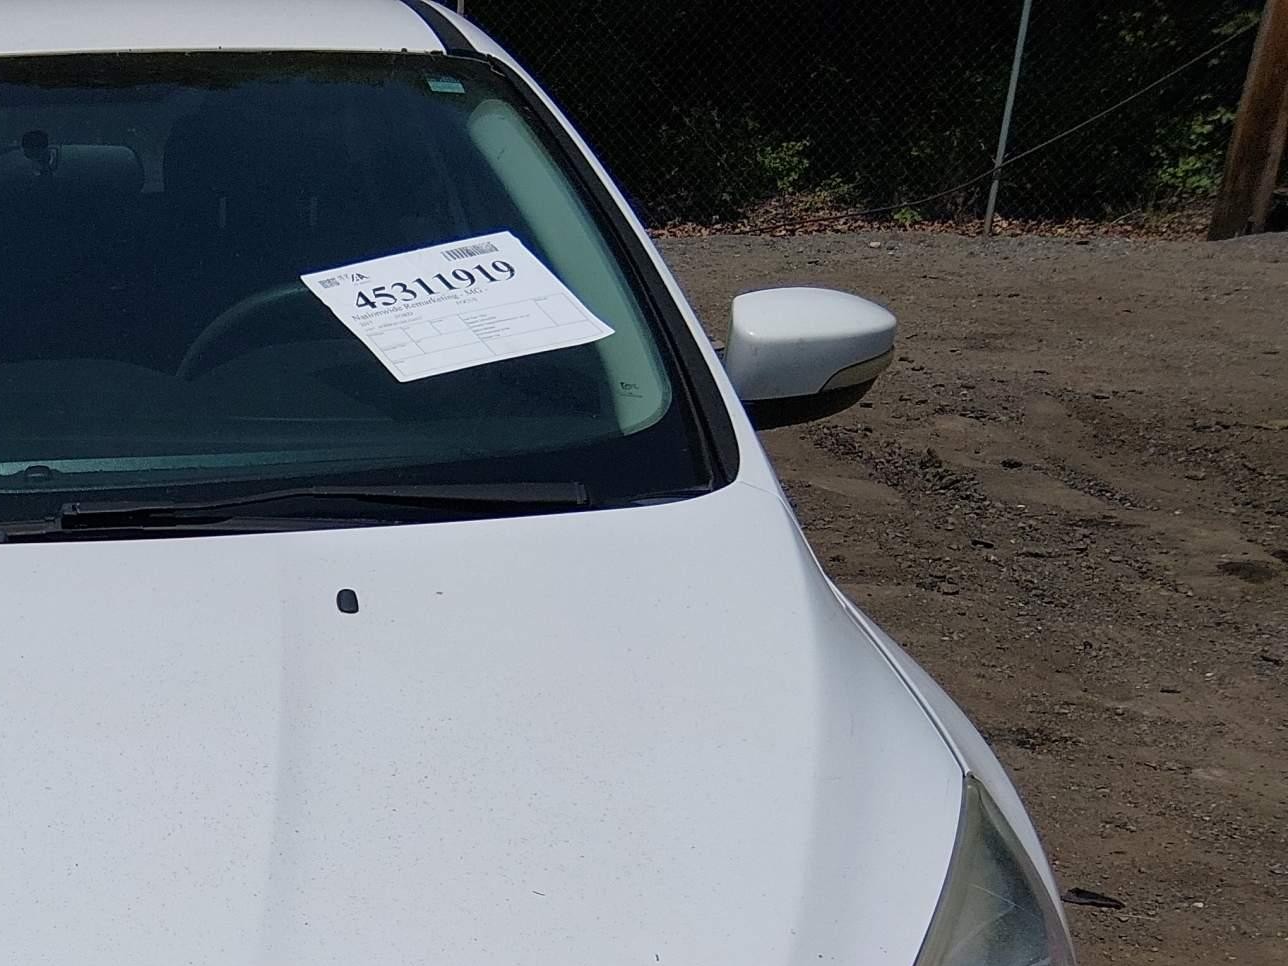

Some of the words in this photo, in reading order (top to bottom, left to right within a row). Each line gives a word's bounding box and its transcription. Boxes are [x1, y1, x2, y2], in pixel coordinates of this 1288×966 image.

[355, 259, 516, 309] 45311919
[351, 304, 404, 321] Nationwide
[404, 292, 460, 310] Remarketing
